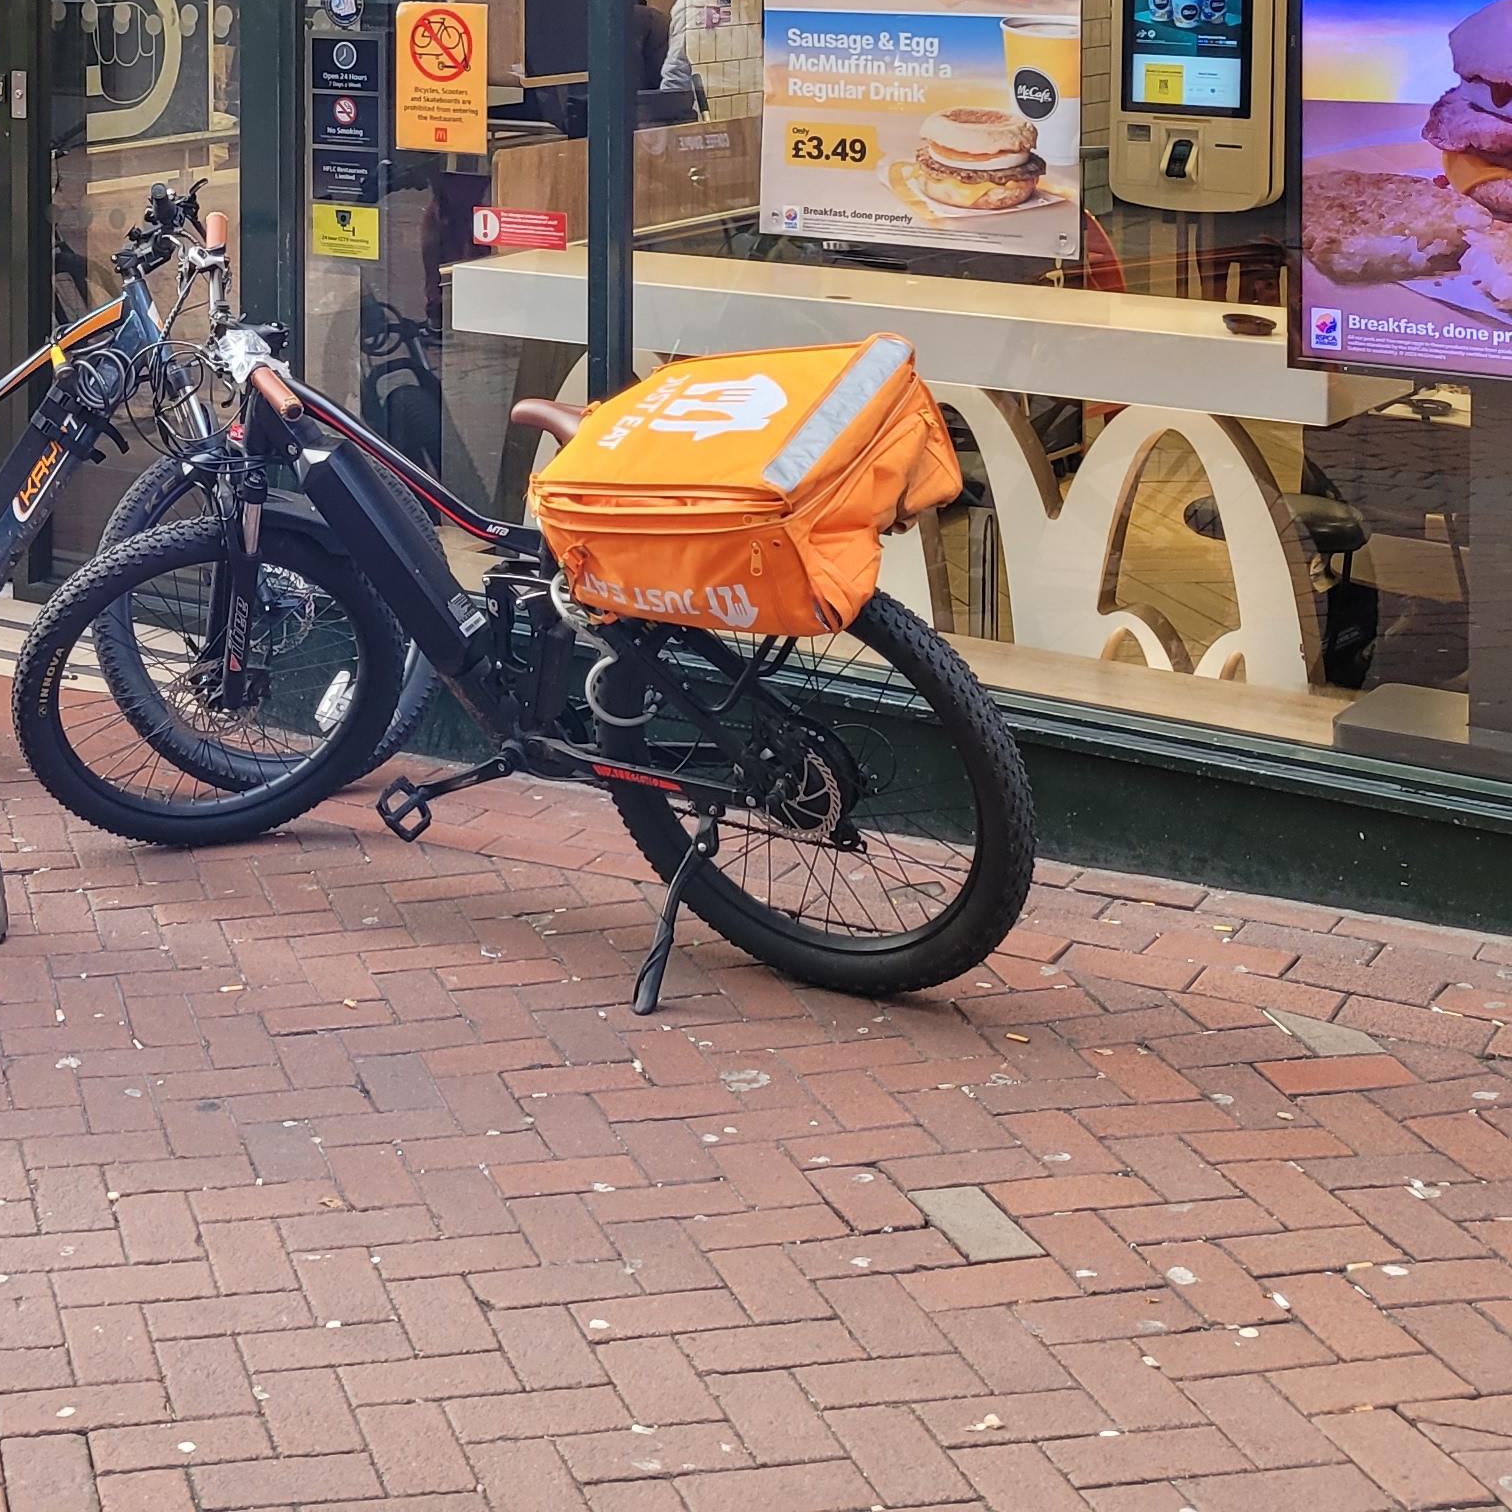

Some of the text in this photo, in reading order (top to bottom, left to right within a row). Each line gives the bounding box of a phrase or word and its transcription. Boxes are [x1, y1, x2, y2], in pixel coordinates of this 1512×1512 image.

[788, 28, 939, 57] Sausage & Egg
[895, 60, 933, 77] and
[939, 64, 952, 78] a
[423, 96, 460, 104] Skateboards
[788, 78, 866, 102] Regular
[453, 108, 478, 116] entering
[337, 128, 363, 136] Smoking
[792, 127, 809, 136] Only
[792, 136, 867, 163] £3.49
[803, 206, 912, 224] Breakfast, done properly
[1348, 314, 1439, 339] Breakfast,
[1443, 323, 1488, 340] done
[596, 374, 692, 450] JUST EAT
[486, 524, 510, 537] MTB
[584, 571, 701, 614] JUST EAT
[39, 648, 65, 702] INNOVA
